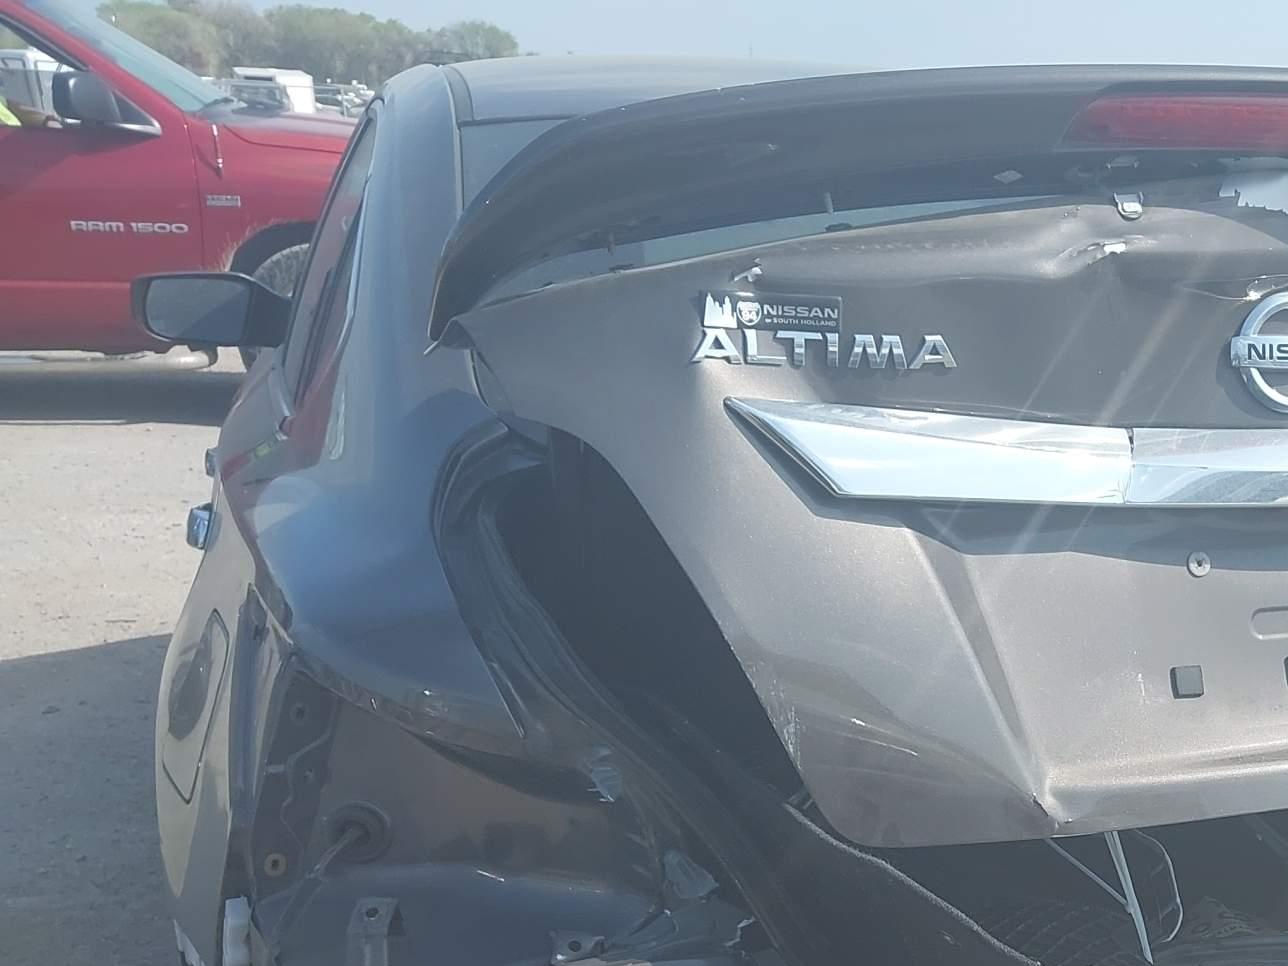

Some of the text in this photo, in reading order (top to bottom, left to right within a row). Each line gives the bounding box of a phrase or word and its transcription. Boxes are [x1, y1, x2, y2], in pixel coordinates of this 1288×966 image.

[70, 220, 189, 234] RAM 1500
[763, 303, 838, 319] NISSAN
[773, 317, 799, 325] SOUTH
[800, 319, 837, 327] HOLLAND
[690, 327, 957, 370] ALTIMA
